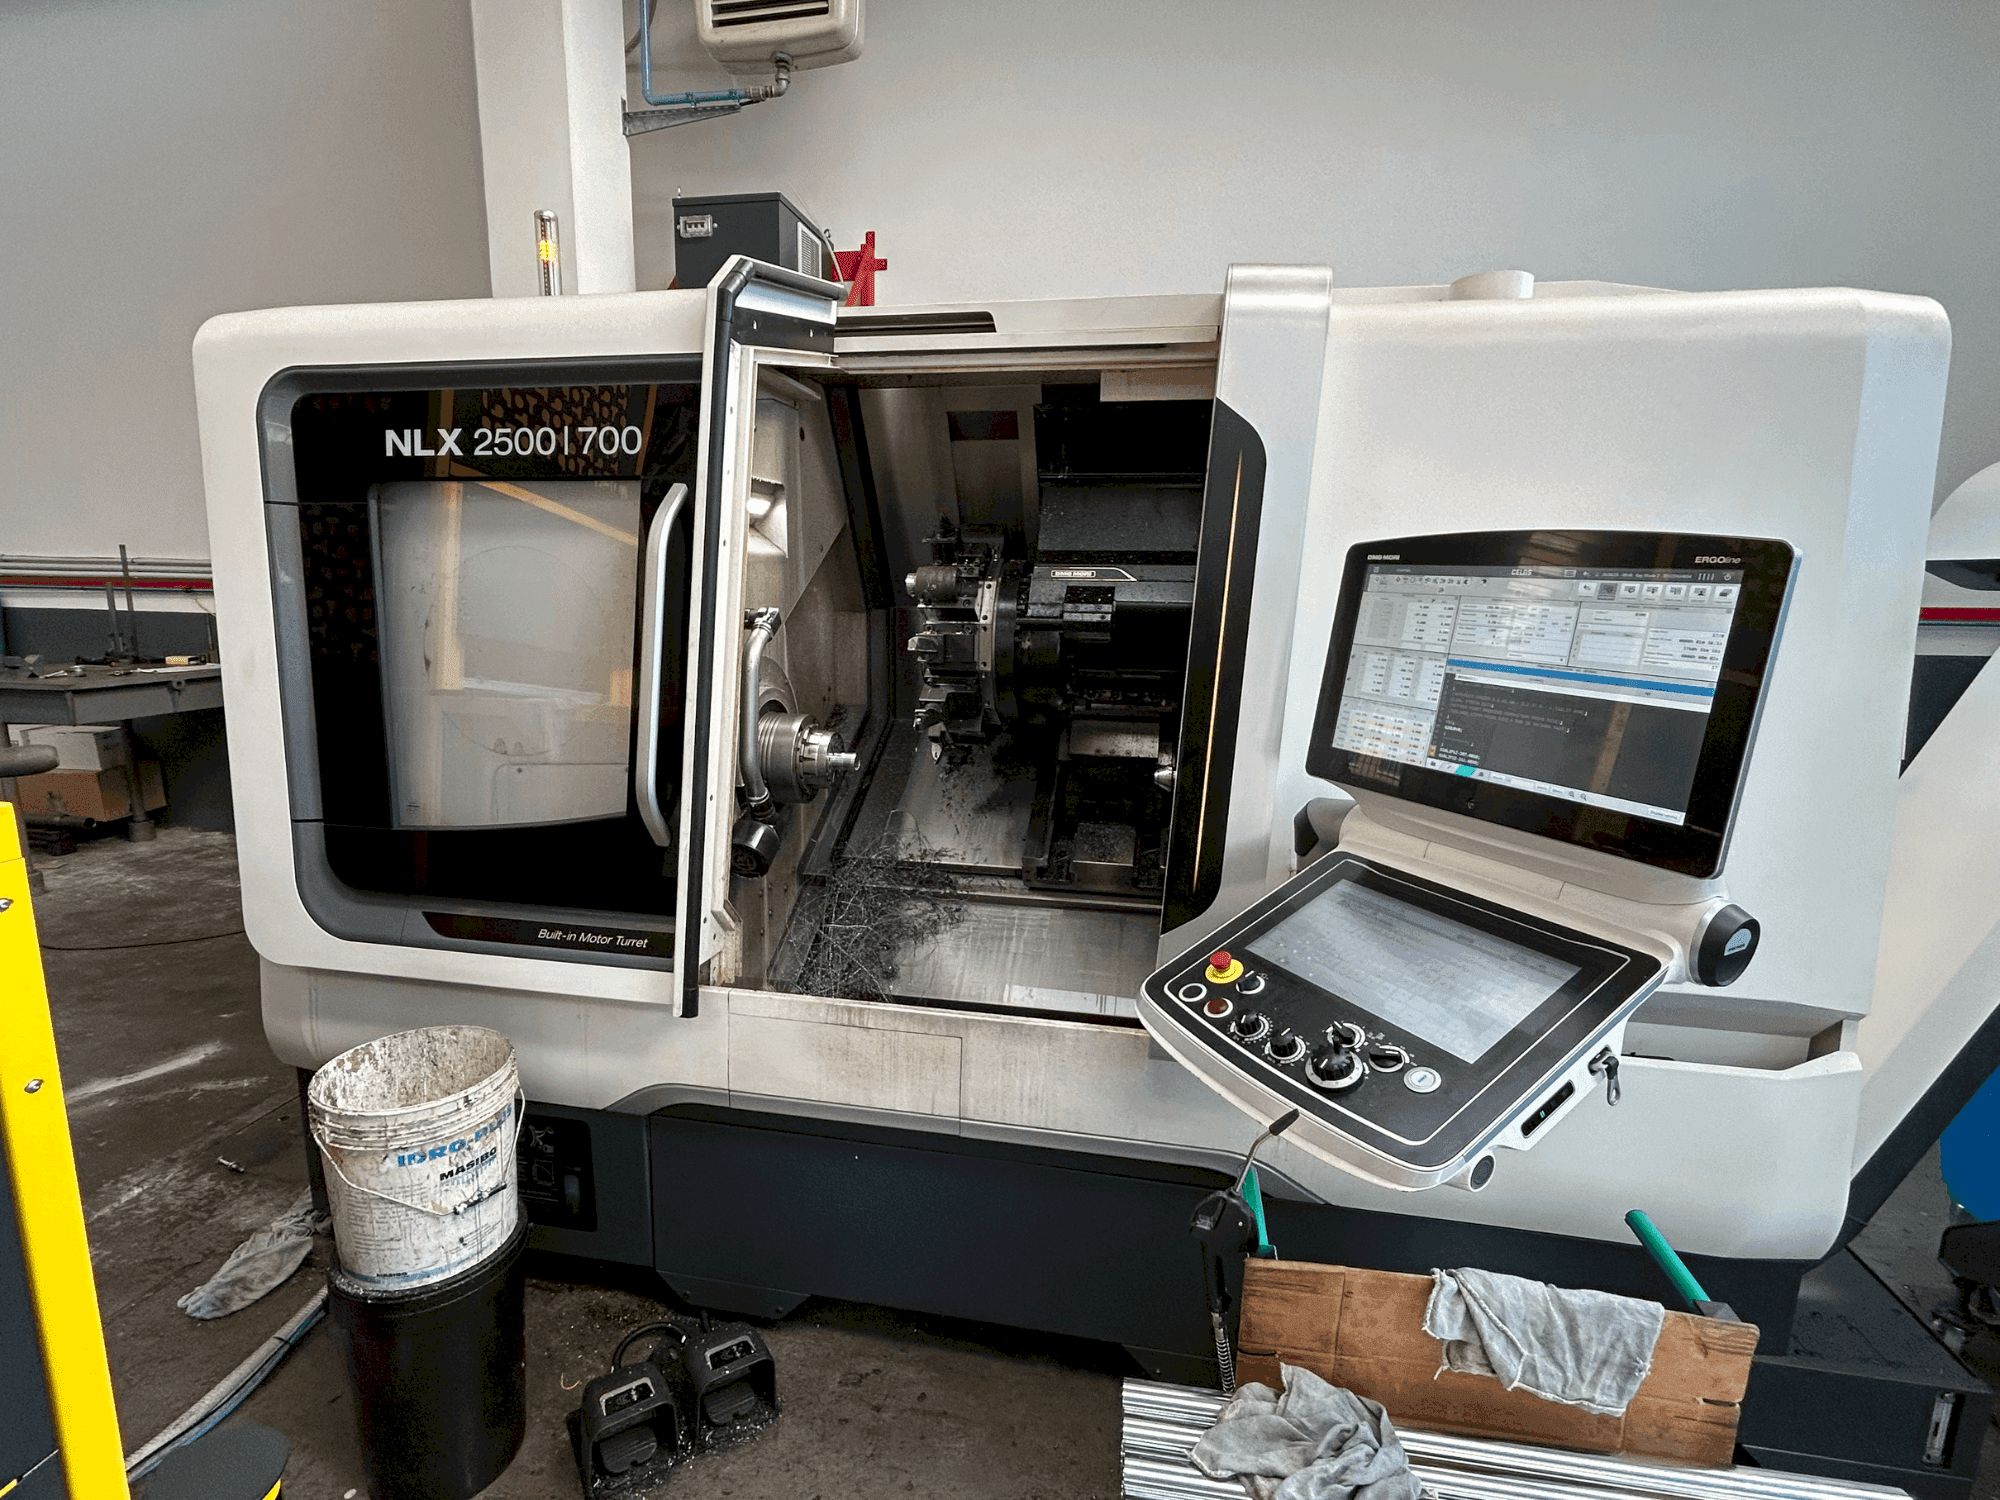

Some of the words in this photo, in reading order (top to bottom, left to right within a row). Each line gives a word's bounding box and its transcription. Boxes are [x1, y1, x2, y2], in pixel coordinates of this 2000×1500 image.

[385, 428, 464, 457] NLX
[1694, 555, 1742, 564] ERGOline
[1511, 568, 1533, 576] CELOS
[538, 928, 577, 942] Built-in
[579, 932, 614, 945] Motor
[616, 935, 648, 949] Turret
[440, 1146, 497, 1181] MASIBO
